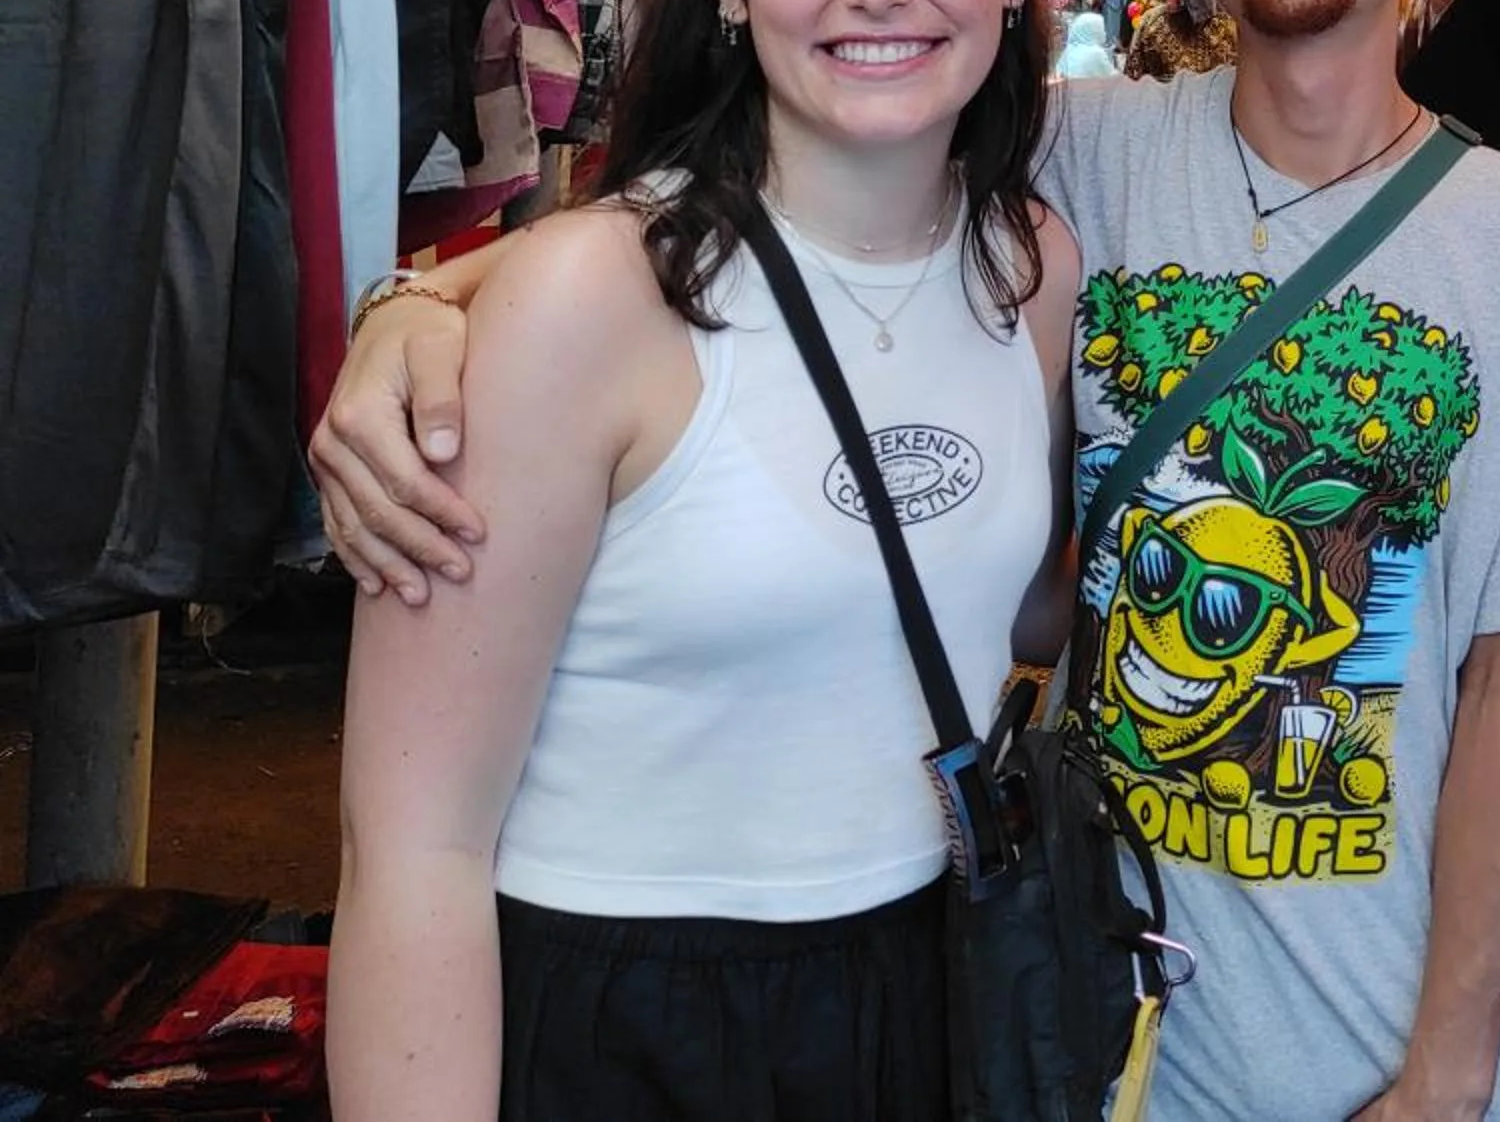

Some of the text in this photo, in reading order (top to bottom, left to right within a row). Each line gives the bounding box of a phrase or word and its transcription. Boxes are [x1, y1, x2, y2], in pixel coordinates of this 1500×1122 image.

[868, 430, 960, 459] EEKEND
[837, 466, 973, 521] COECTIVE
[1108, 777, 1386, 879] ON LIFE
